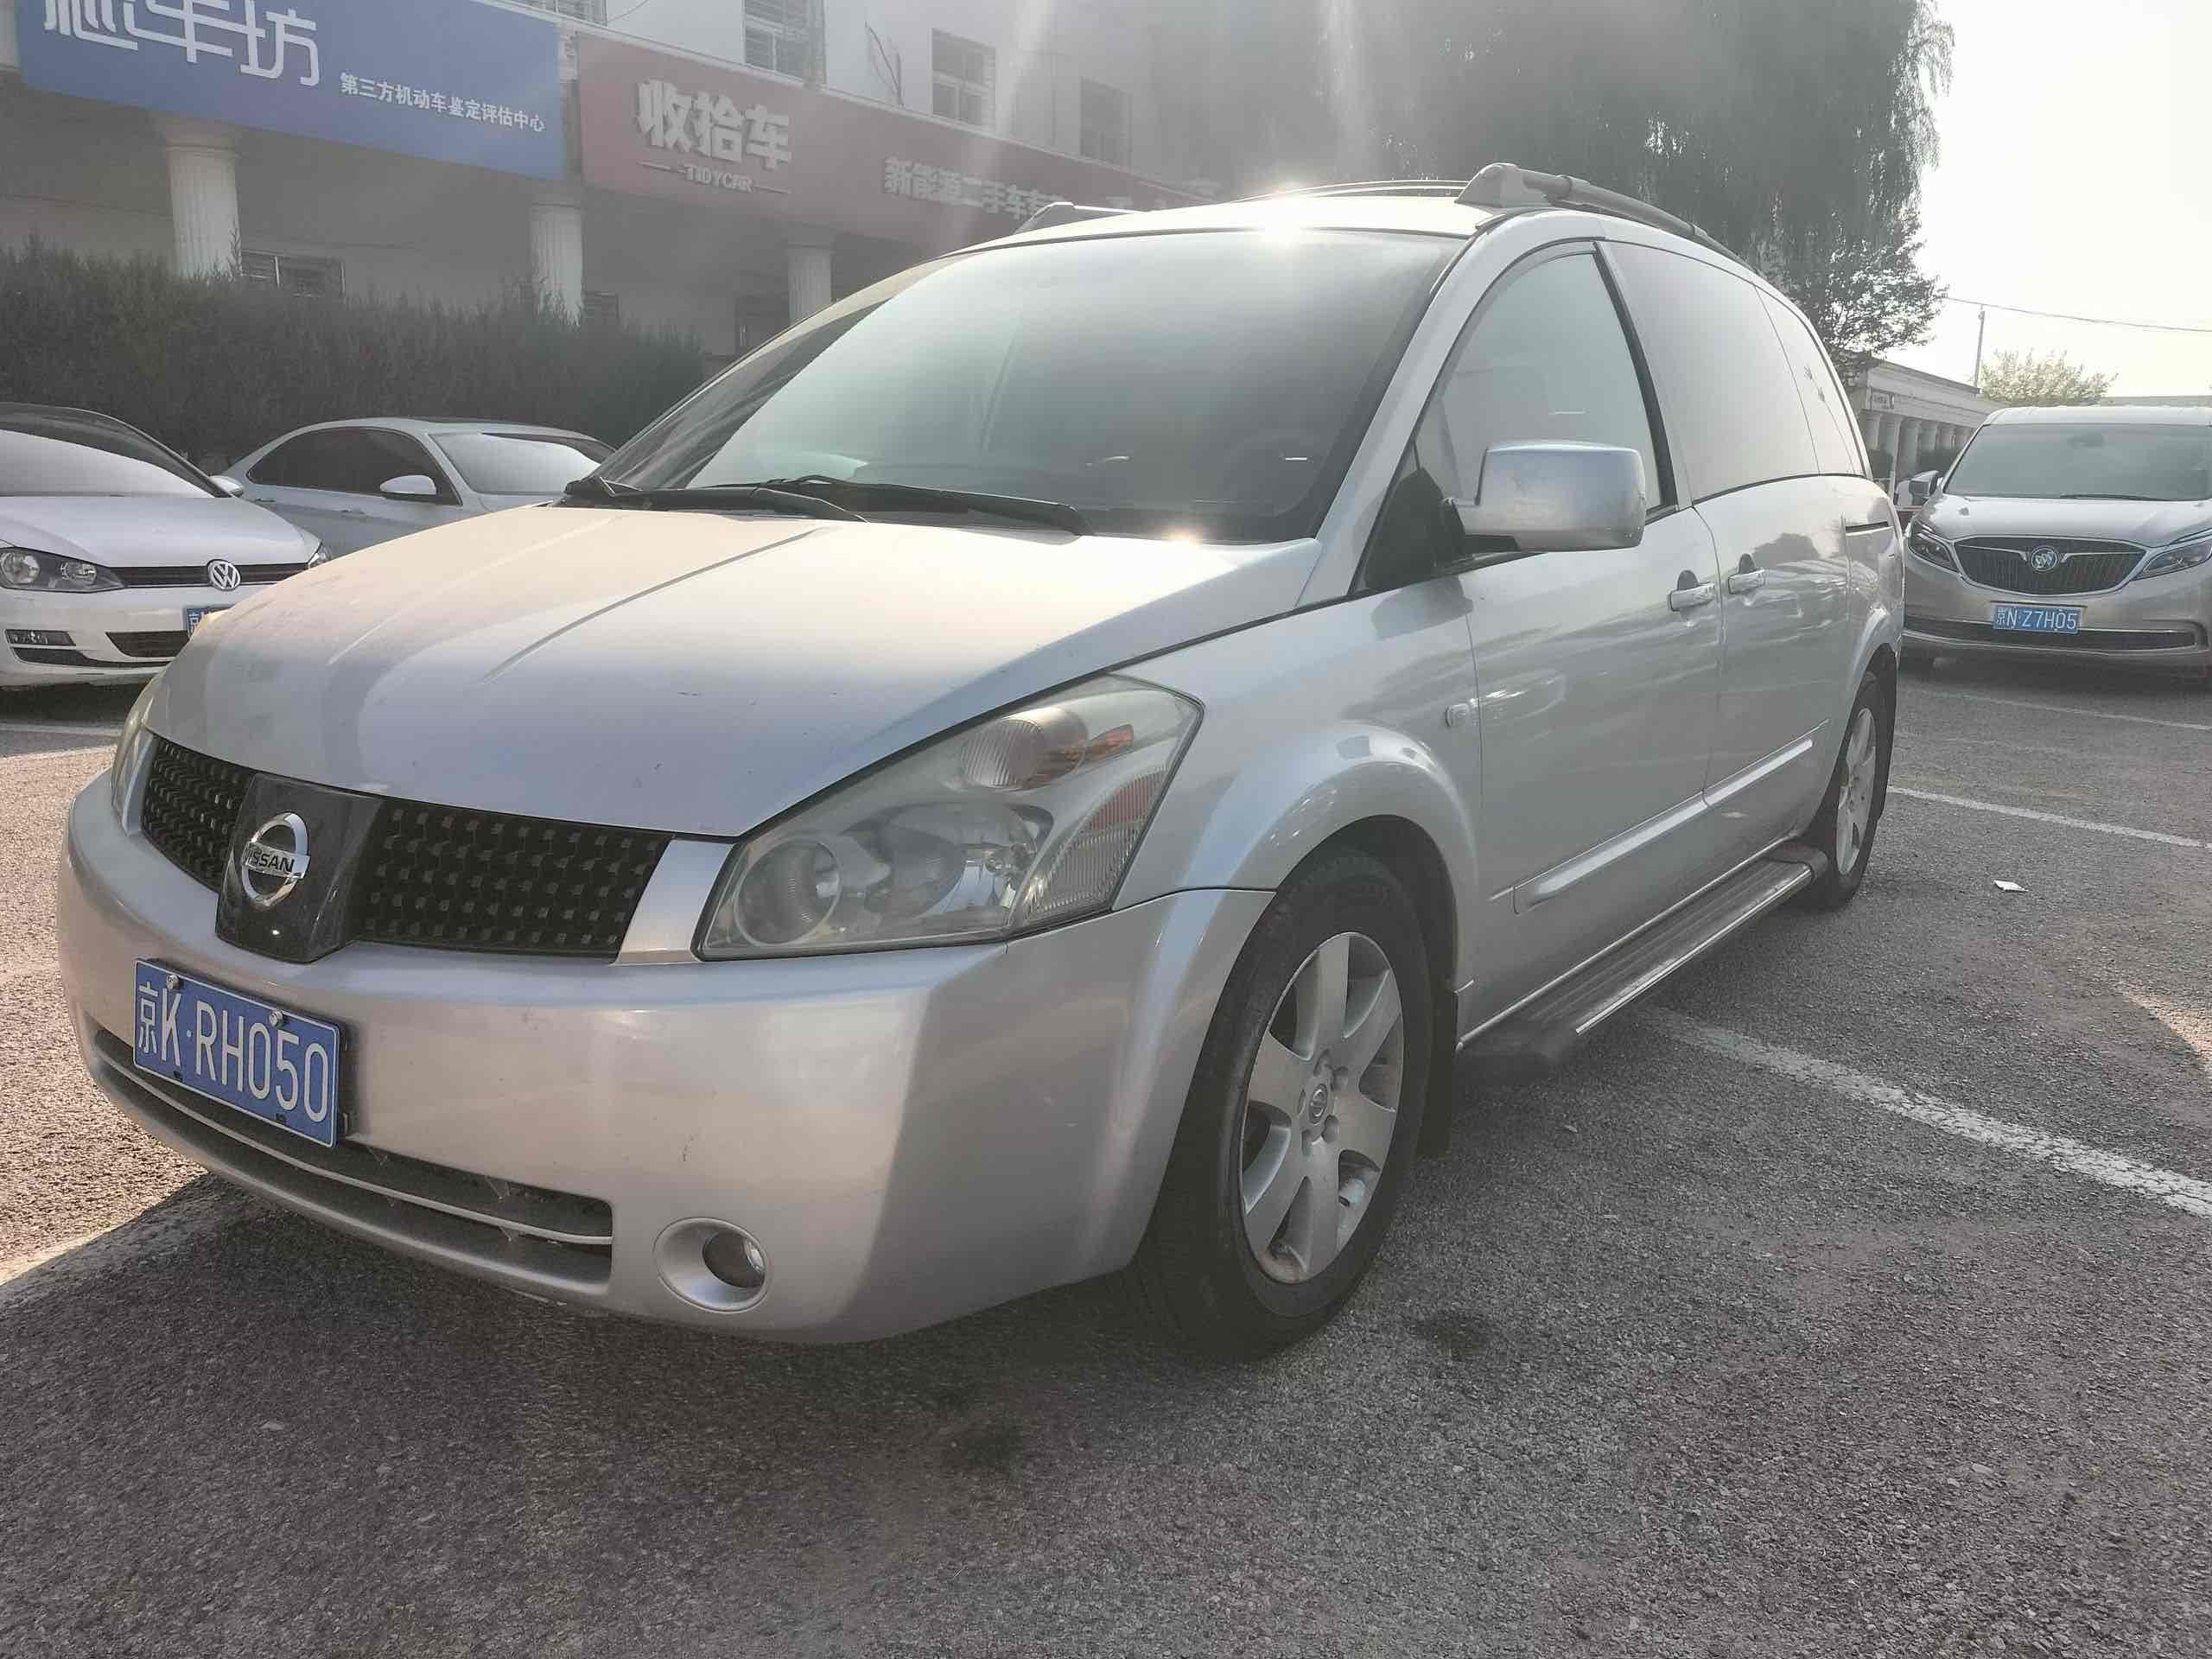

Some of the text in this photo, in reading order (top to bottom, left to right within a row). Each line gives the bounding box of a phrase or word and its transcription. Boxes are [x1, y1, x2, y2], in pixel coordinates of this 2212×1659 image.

[340, 72, 546, 132] 第三方机动车鉴定评估中心
[637, 79, 792, 171] 收拾车
